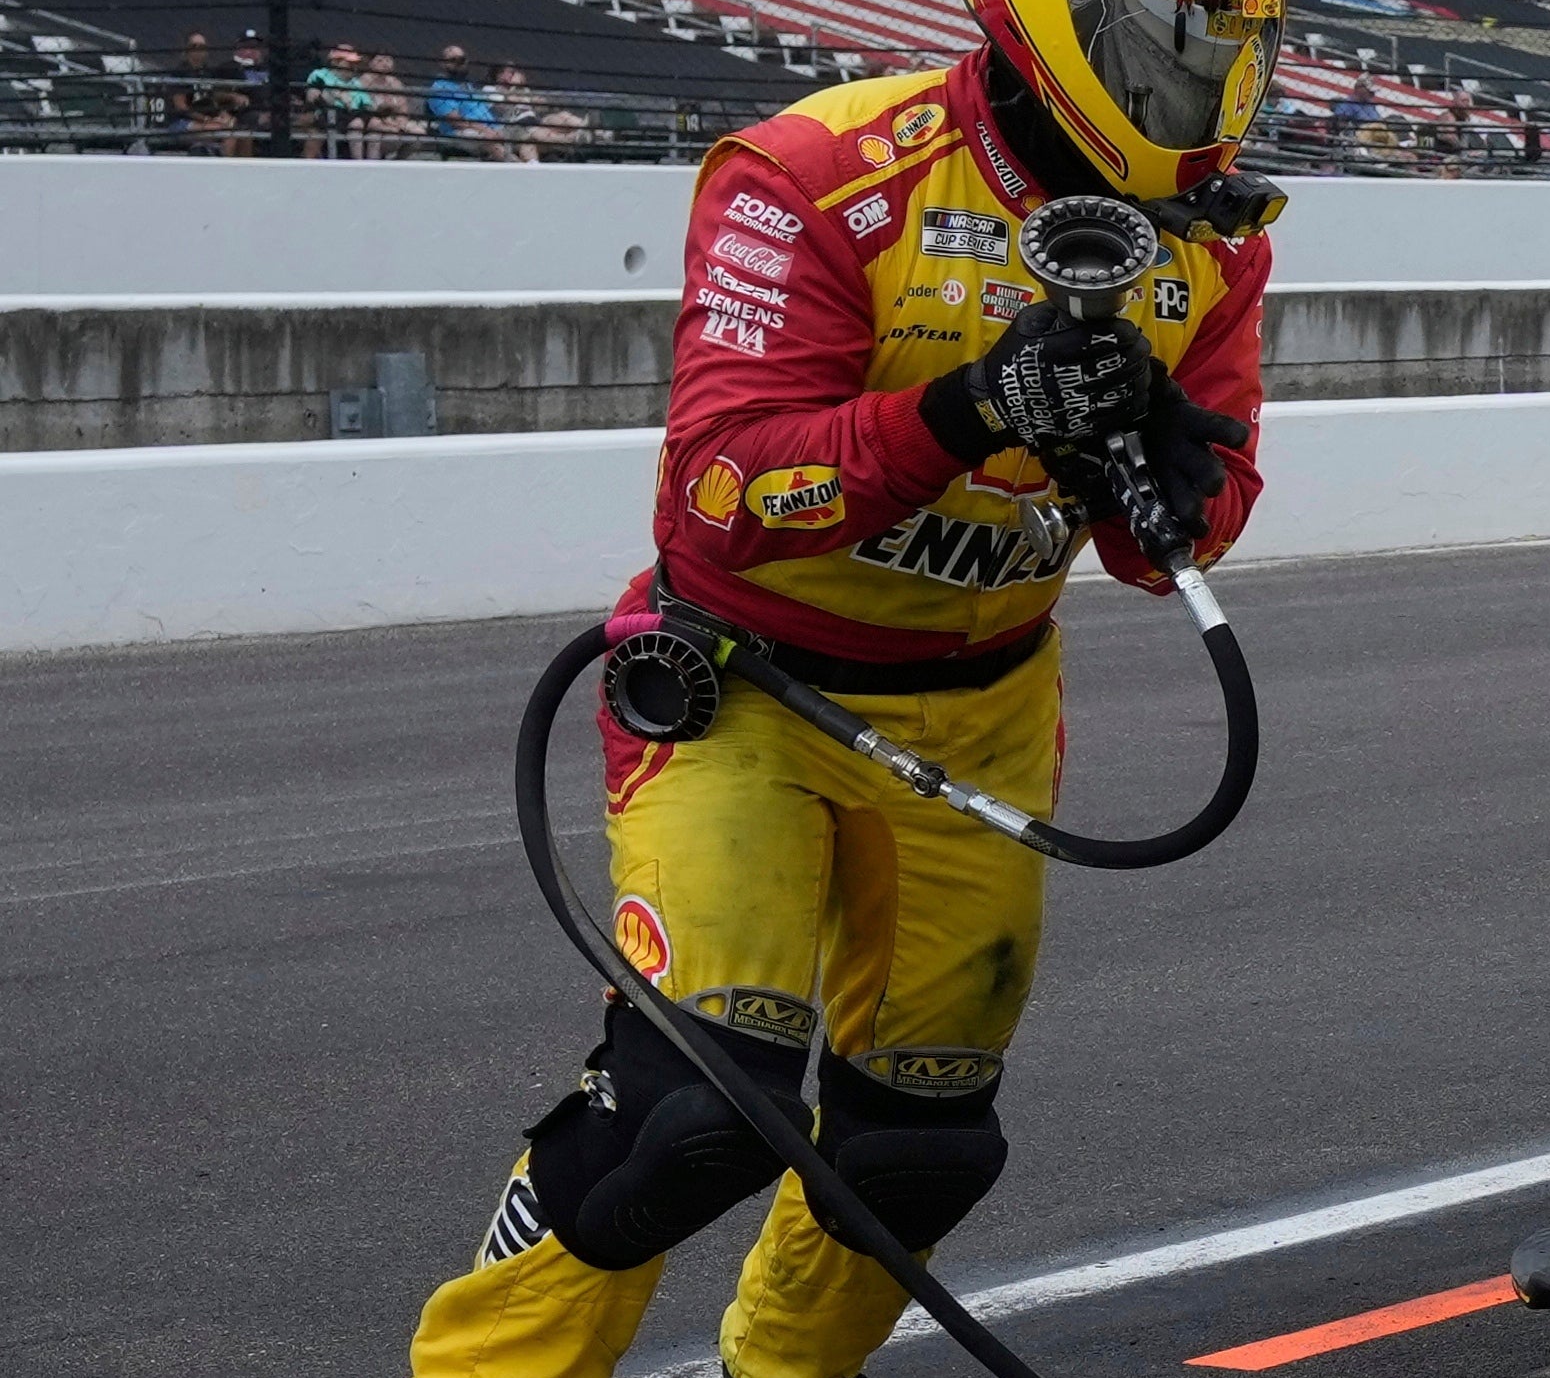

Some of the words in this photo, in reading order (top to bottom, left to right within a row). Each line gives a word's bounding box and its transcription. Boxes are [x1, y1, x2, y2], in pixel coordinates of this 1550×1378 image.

[896, 108, 936, 143] PENNZOIL
[724, 209, 795, 244] PERFORMANCE
[729, 192, 804, 233] FORD
[848, 198, 889, 232] OMP
[949, 213, 995, 234] NASCAR
[935, 233, 957, 246] CUP
[958, 235, 996, 252] SERIES
[705, 262, 789, 308] Mazak
[696, 288, 784, 329] SIEMENS
[718, 314, 767, 353] PVA
